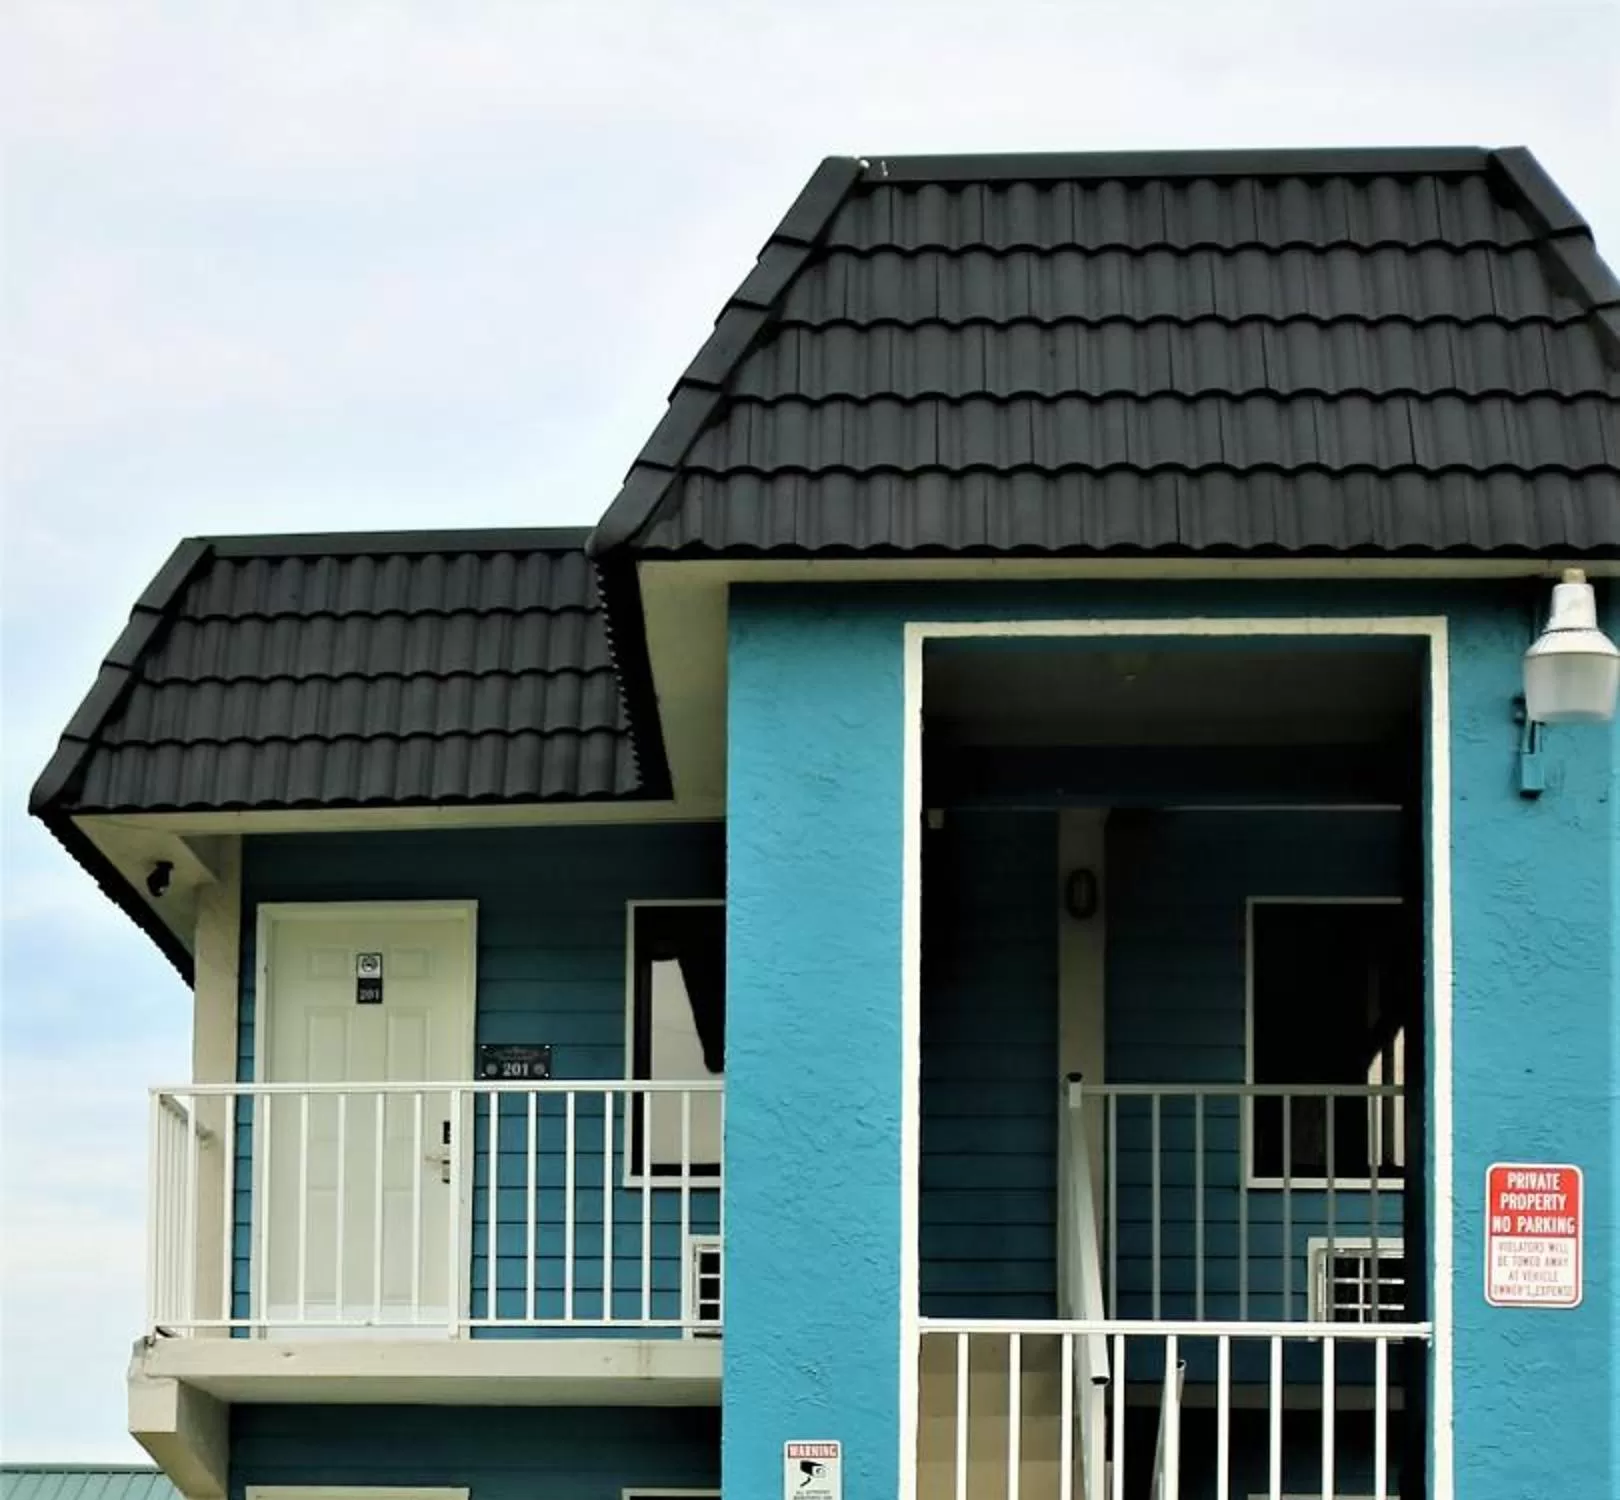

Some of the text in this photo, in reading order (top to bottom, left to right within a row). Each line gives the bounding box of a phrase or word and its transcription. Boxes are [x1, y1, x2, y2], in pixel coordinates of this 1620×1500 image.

[502, 1062, 529, 1077] 201
[1507, 1171, 1561, 1191] PRIVATE
[1499, 1193, 1568, 1211] PROPERTY
[1492, 1215, 1576, 1234] NO PARKING
[1498, 1241, 1569, 1254] VIOLATORS WILL
[1497, 1255, 1569, 1267] BE TOWED AWAY
[1507, 1269, 1559, 1282] AT VEHICLE
[789, 1445, 837, 1457] WARNING
